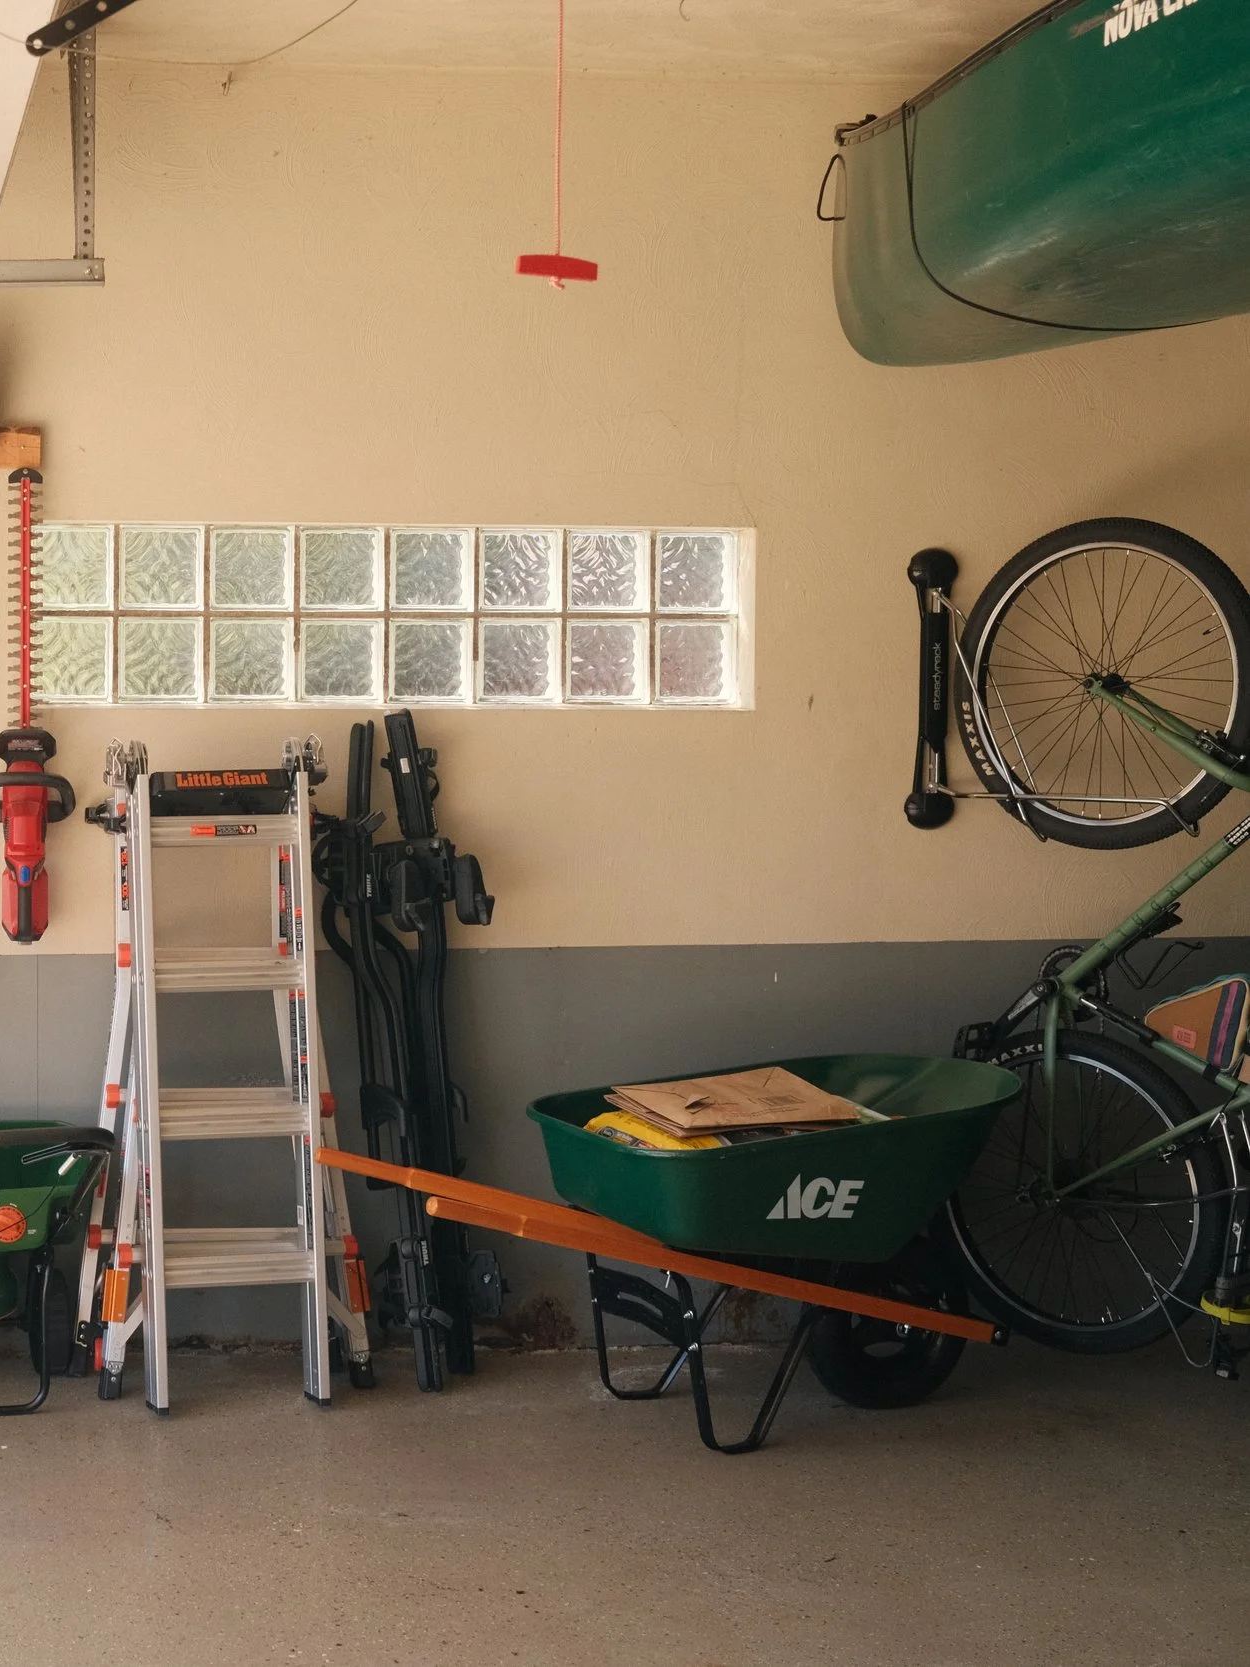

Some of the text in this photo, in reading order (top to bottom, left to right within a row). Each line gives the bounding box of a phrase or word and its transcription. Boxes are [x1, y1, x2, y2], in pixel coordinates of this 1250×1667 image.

[932, 642, 942, 711] steadyrack
[961, 701, 997, 776] MAXXIS
[986, 1043, 1044, 1066] MAXXI
[766, 1173, 864, 1220] ACE
[420, 1240, 430, 1266] THULE
